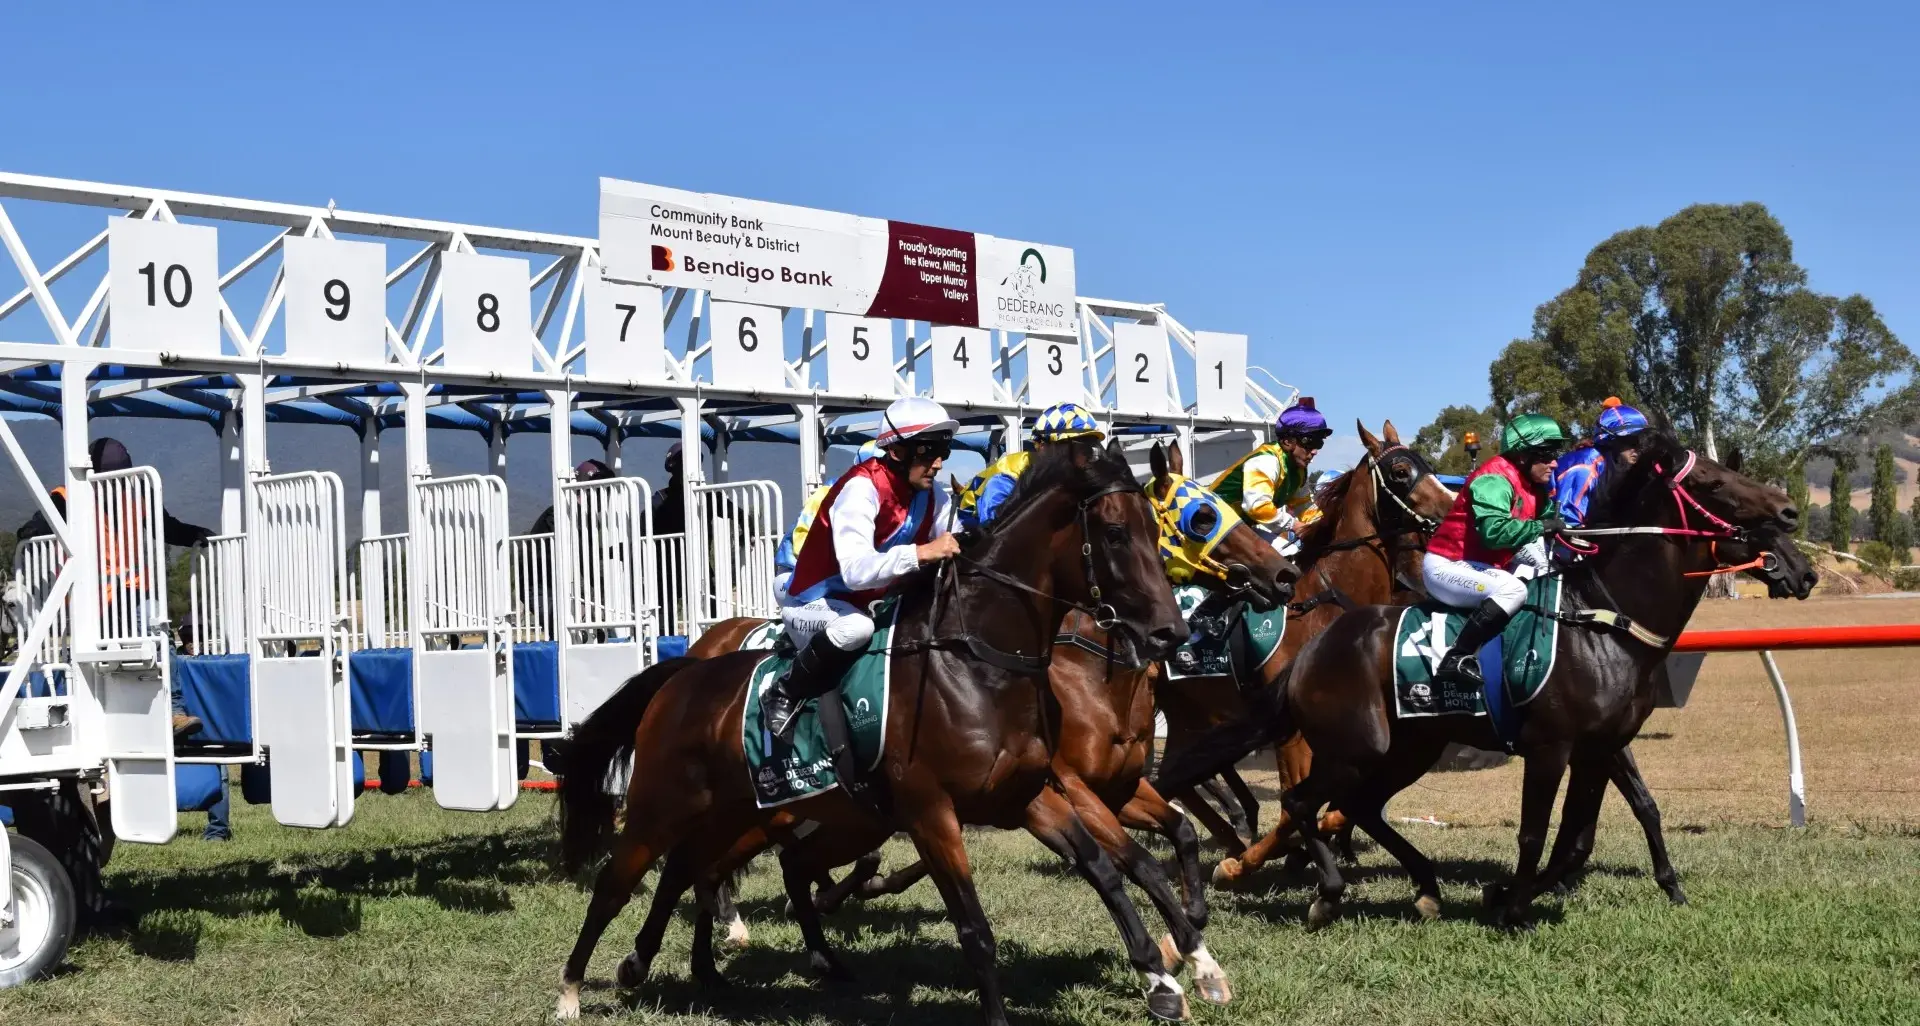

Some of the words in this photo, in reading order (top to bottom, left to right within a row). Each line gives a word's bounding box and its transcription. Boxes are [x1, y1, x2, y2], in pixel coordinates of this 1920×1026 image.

[650, 204, 727, 229] Community
[731, 215, 764, 232] Bank
[650, 223, 692, 241] Mount
[696, 230, 741, 249] Beauty
[745, 235, 753, 248] &
[757, 237, 800, 253] District
[899, 240, 927, 256] Proudly
[929, 244, 967, 261] Supporting
[684, 255, 775, 283] Bendigo
[781, 266, 833, 287] Bank
[903, 254, 916, 265] the
[918, 256, 941, 270] Kiewa,
[943, 260, 960, 273] Mitta
[961, 263, 967, 273] &
[138, 261, 193, 308] 10
[920, 270, 942, 285] Upper
[943, 274, 968, 289] Murray
[323, 278, 351, 321] 9
[943, 287, 969, 303] Valleys
[997, 296, 1064, 318] DEDERANG
[476, 293, 500, 333] 8
[615, 303, 636, 342] 7
[738, 316, 758, 352] 6
[852, 326, 870, 361] 5
[952, 336, 970, 369] 4
[1047, 344, 1063, 376] 3
[1134, 352, 1150, 383] 2
[1214, 360, 1223, 390] 1
[781, 757, 800, 769] THE
[788, 776, 821, 791] HOTEL
